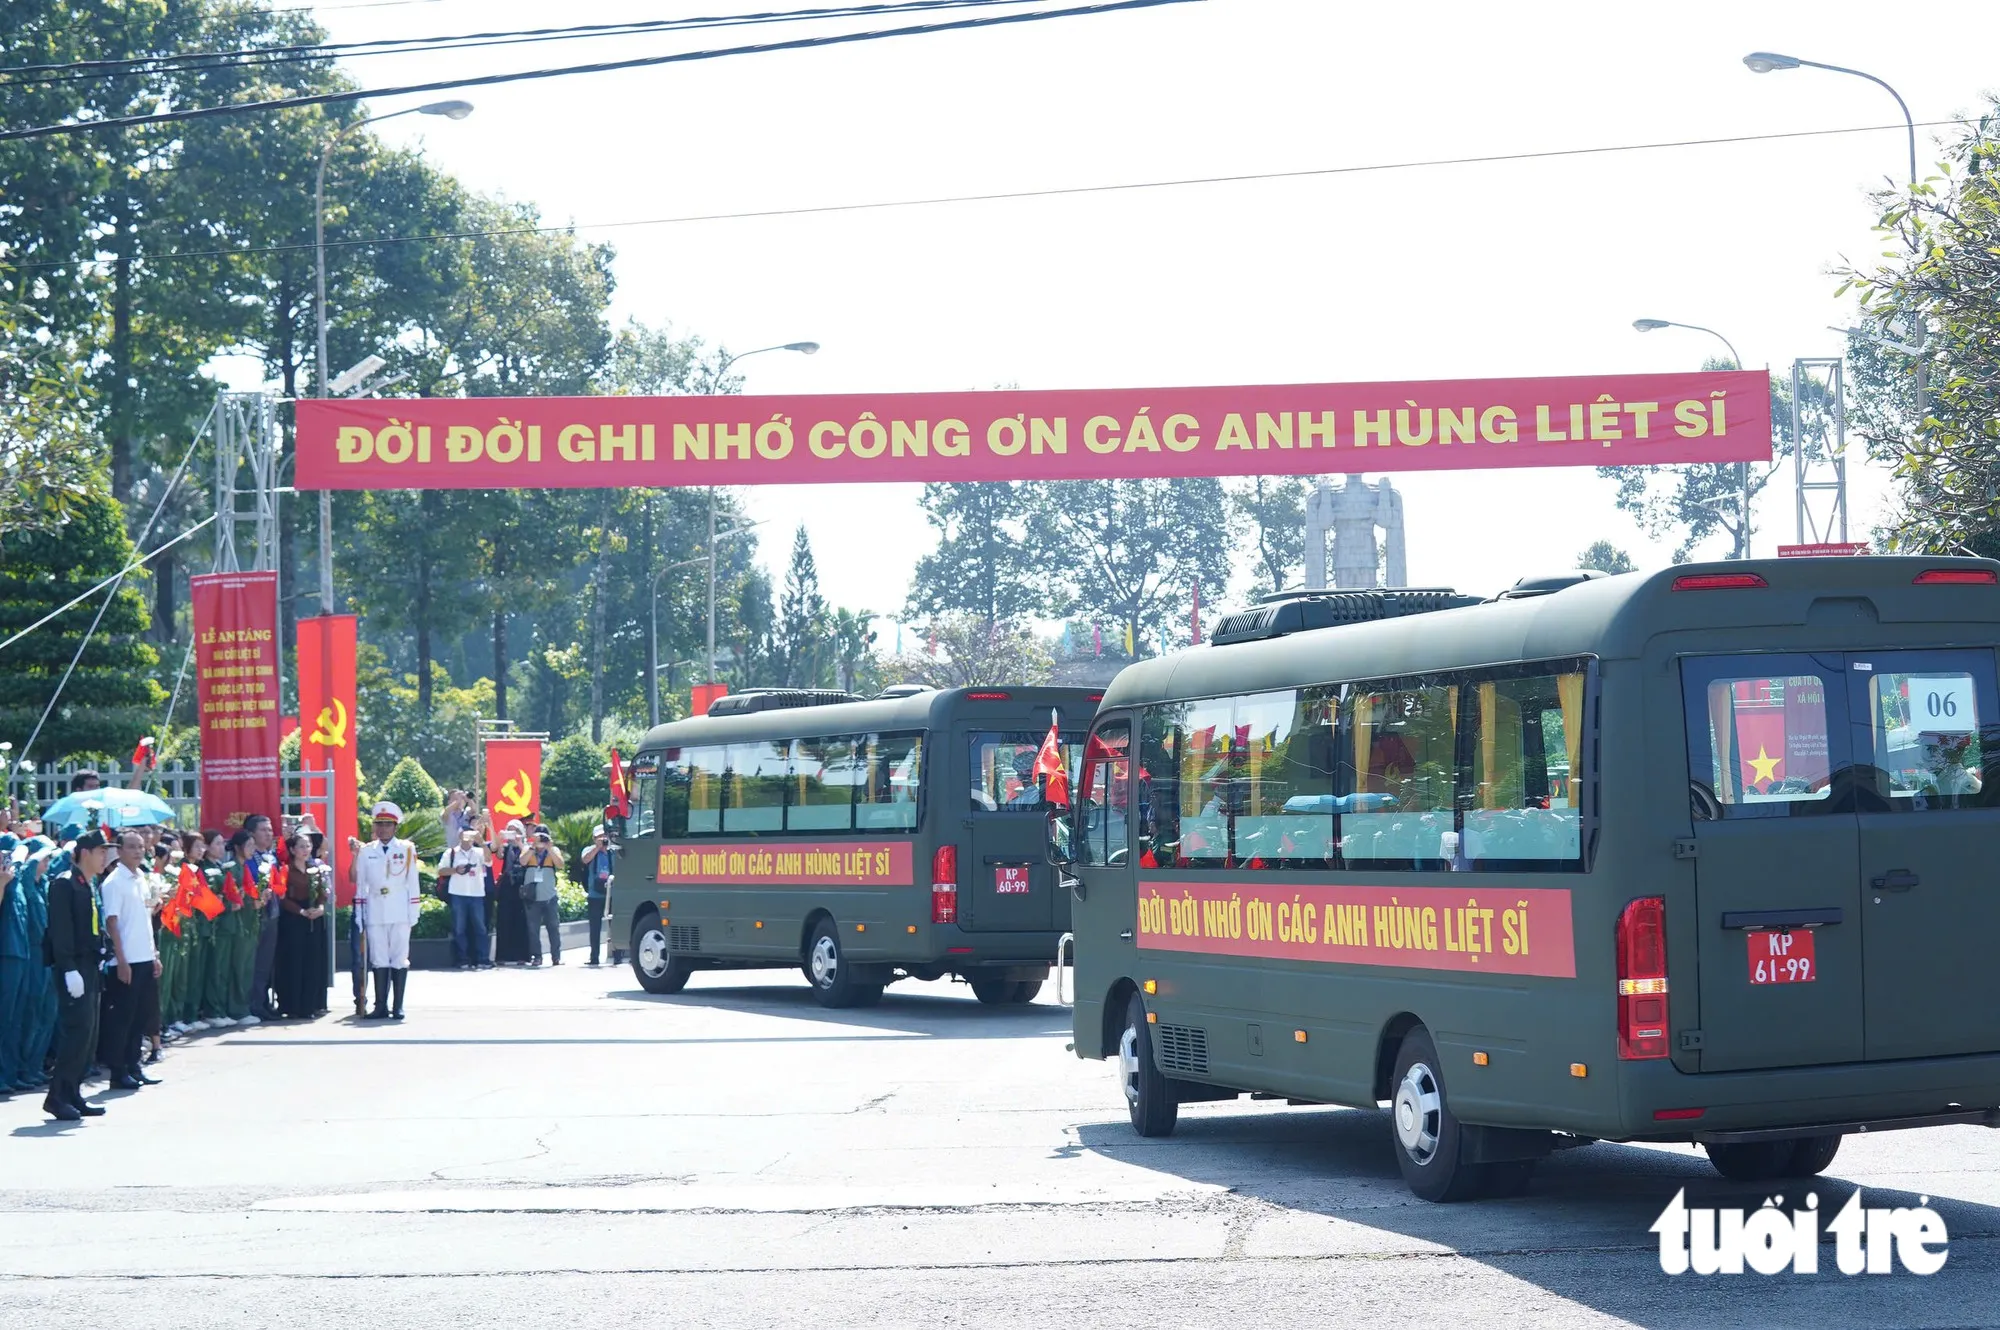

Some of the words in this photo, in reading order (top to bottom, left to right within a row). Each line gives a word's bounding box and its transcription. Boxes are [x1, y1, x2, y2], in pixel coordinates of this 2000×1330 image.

[336, 418, 430, 464] ĐỜI
[446, 417, 541, 463] ĐỜI
[558, 423, 655, 462] GHI
[674, 413, 793, 460] NHỚ
[808, 412, 971, 459] CÔNG
[988, 414, 1066, 455] ƠN
[1083, 406, 1200, 453] CÁC
[1216, 411, 1336, 450] ANH
[1354, 400, 1518, 447] HÙNG
[1537, 394, 1659, 448] LIỆT
[1675, 391, 1726, 438] SĨ
[218, 630, 235, 643] AN
[236, 627, 272, 641] TÁNG
[1927, 691, 1957, 718] 06
[660, 850, 678, 875] ĐỜI
[681, 850, 699, 875] ĐỜI
[702, 850, 727, 875] NHỚ
[729, 851, 746, 875] ƠN
[748, 848, 772, 875] CÁC
[775, 853, 802, 875] ANH
[805, 849, 841, 876] HÙNG
[844, 848, 872, 881] LIỆT
[875, 848, 890, 876] SĨ
[1005, 868, 1018, 880] KP
[999, 881, 1027, 893] 60-99
[1139, 889, 1167, 935] ĐỜI
[1170, 890, 1199, 936] ĐỜI
[1203, 892, 1241, 940] NHỚ
[1246, 897, 1273, 941] ƠN
[1278, 895, 1317, 944] CÁC
[1324, 904, 1368, 947] ANH
[1374, 897, 1438, 951] HÙNG
[1444, 898, 1494, 963] LIỆT
[1503, 901, 1529, 955] SĨ
[1769, 933, 1793, 956] KP
[1755, 958, 1810, 982] 61-99
